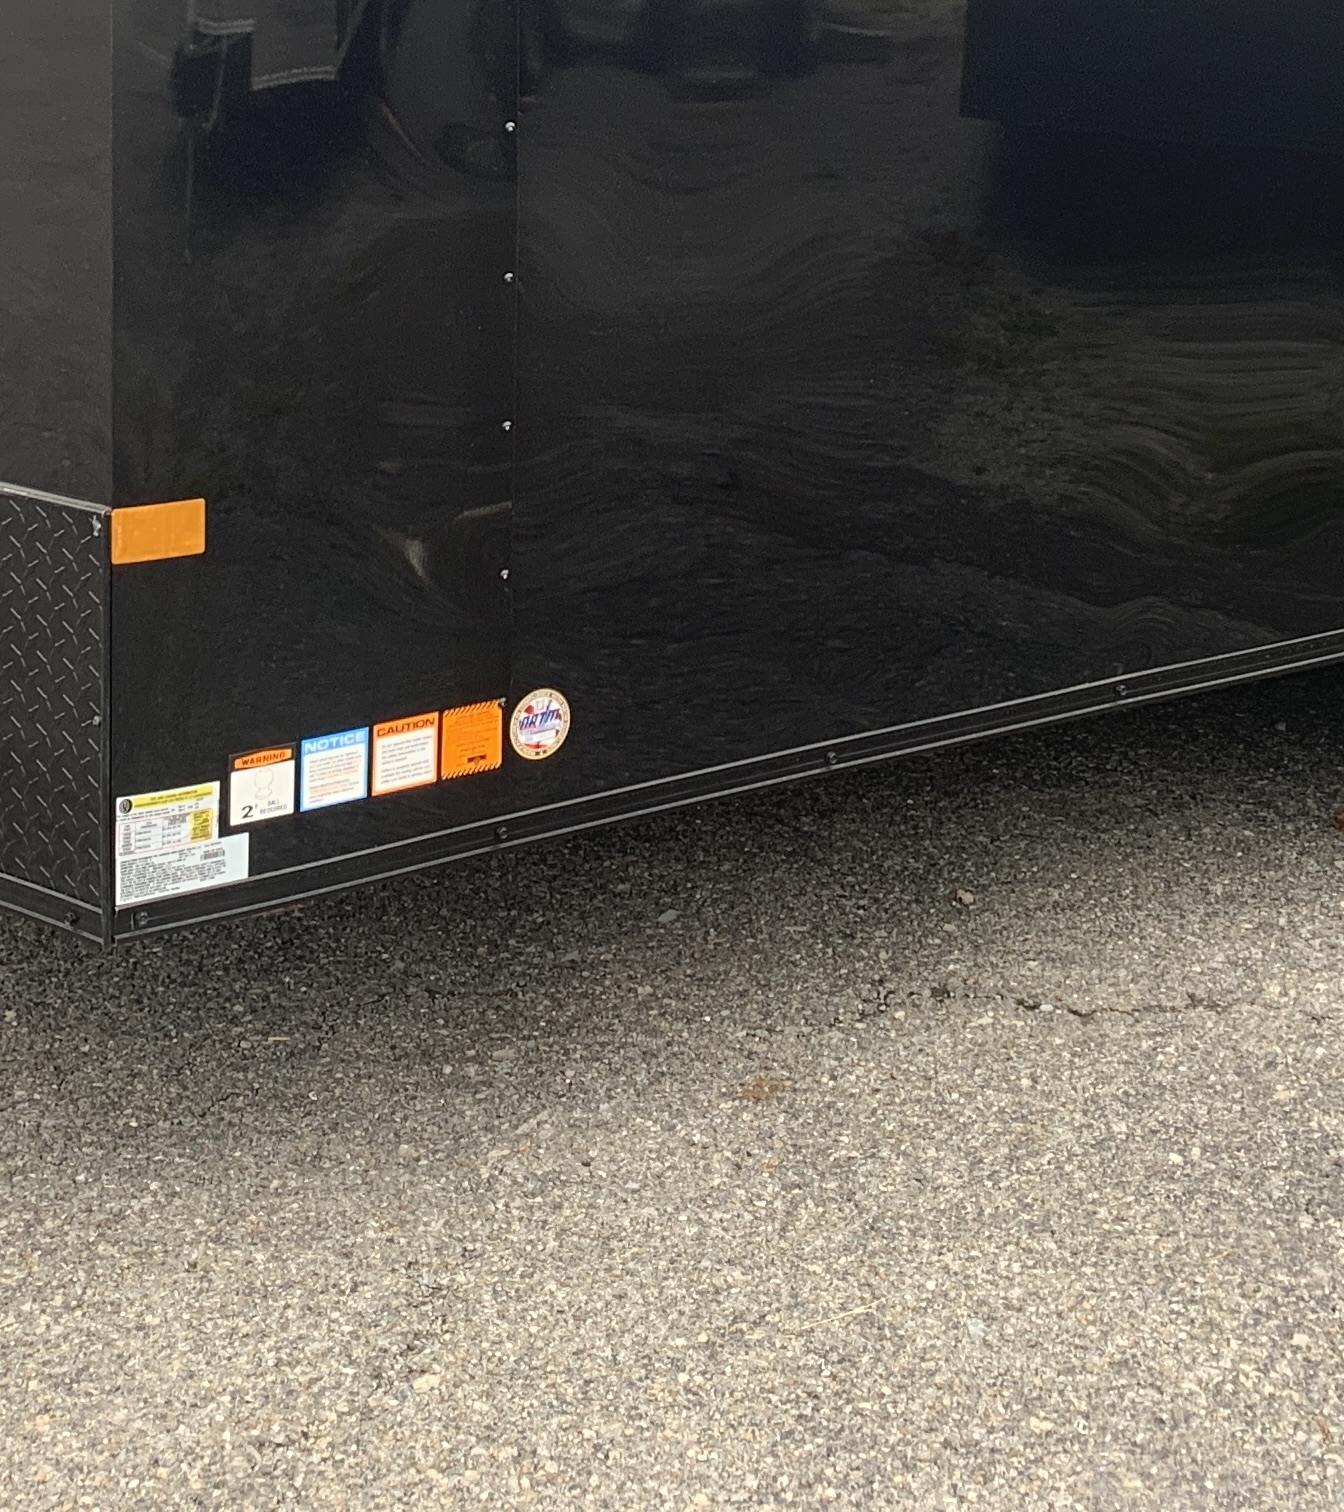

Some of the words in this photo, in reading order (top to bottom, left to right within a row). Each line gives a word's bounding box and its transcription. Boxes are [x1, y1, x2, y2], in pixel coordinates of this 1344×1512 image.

[377, 717, 435, 737] CAUTION
[304, 730, 366, 754] NOTICE
[241, 751, 286, 766] WARNING
